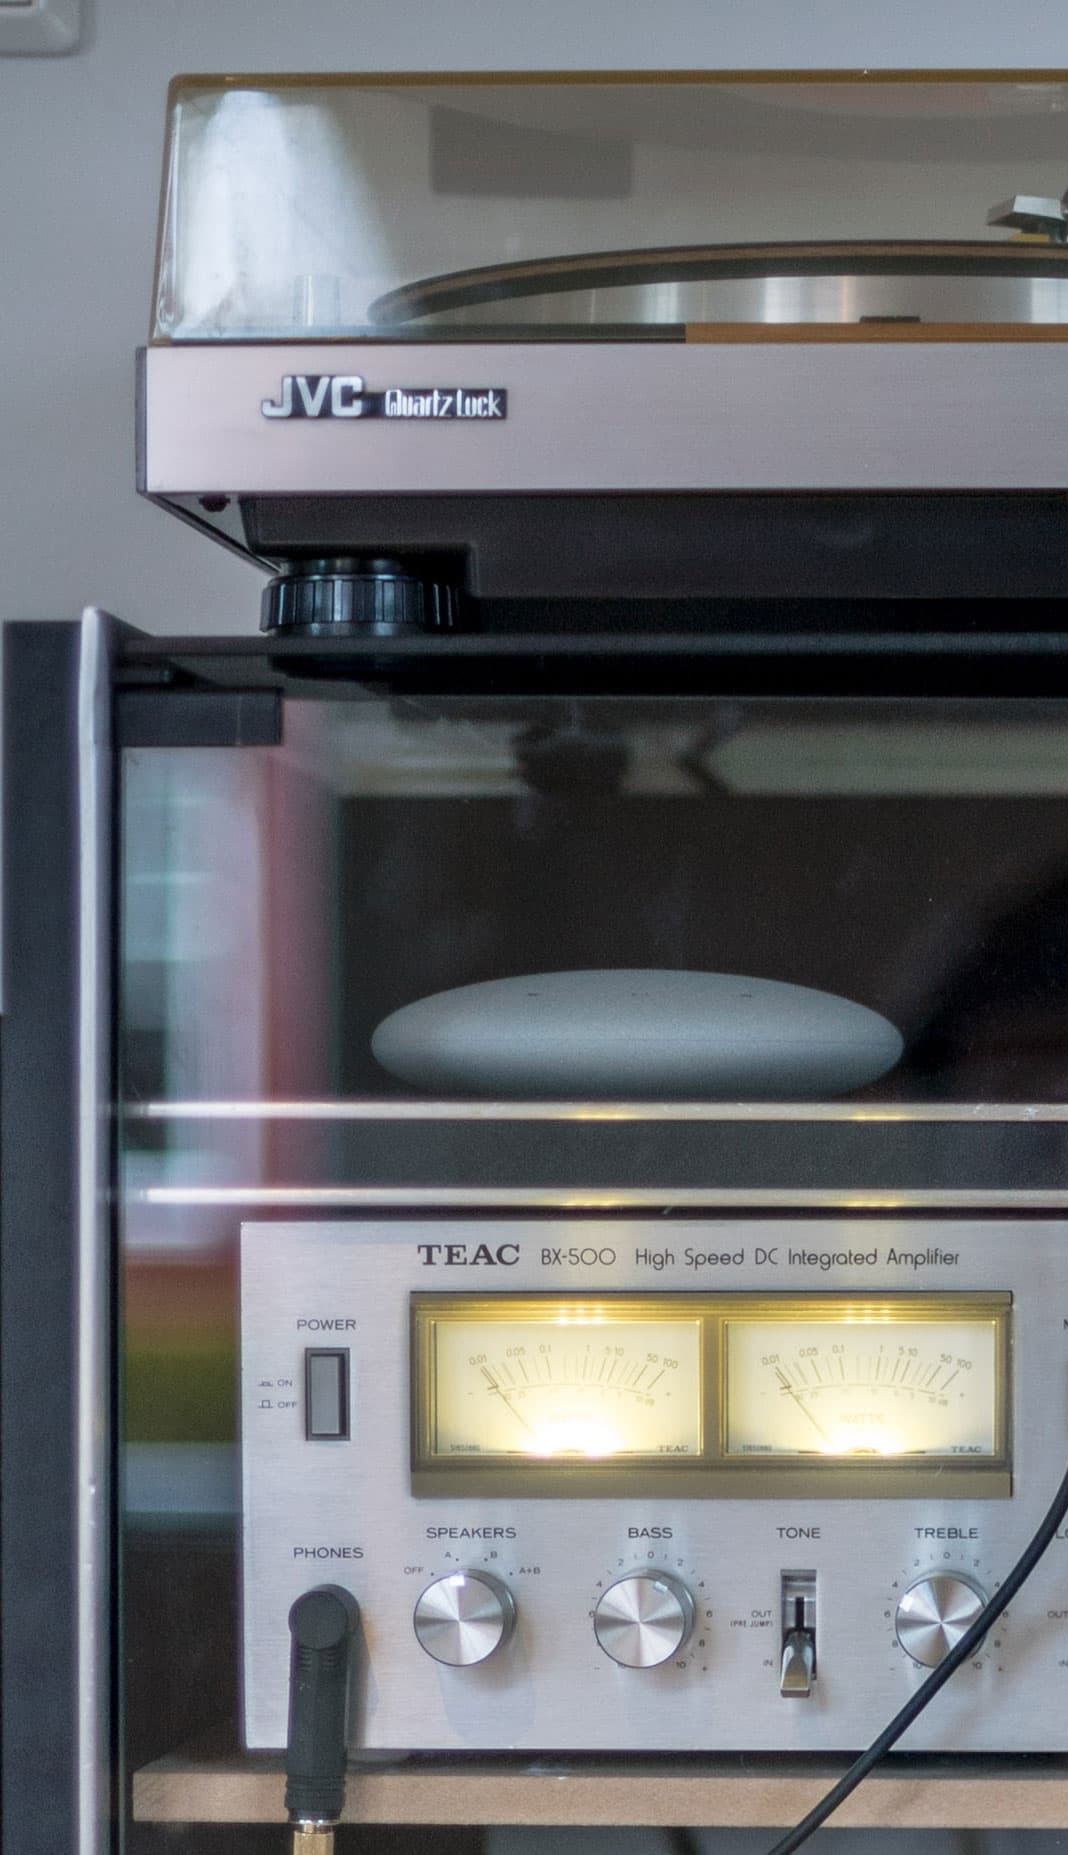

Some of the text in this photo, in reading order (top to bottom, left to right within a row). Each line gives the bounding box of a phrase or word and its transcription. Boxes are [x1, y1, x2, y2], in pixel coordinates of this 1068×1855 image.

[261, 375, 364, 418] JVC
[384, 388, 452, 417] Quartz
[417, 1244, 960, 1271] TEAC BX-500 High Speed DC Integrated Amplifier
[296, 1319, 357, 1331] POWER
[506, 1347, 527, 1358] 0.05
[539, 1344, 552, 1354] 0.1
[799, 1347, 819, 1358] 0.05
[832, 1344, 845, 1354] 0.1
[908, 1347, 918, 1357] 10
[469, 1354, 488, 1366] 0.01
[646, 1353, 659, 1364] 50
[662, 1358, 679, 1370] 100
[762, 1354, 780, 1366] 0.01
[940, 1353, 953, 1365] 50
[956, 1358, 973, 1370] 100
[277, 1379, 293, 1387] ON
[277, 1401, 297, 1409] OFF
[658, 1445, 689, 1453] TEAC
[951, 1445, 982, 1454] TEAC
[426, 1527, 517, 1539] SPEAKERS
[628, 1527, 673, 1539] BASS
[776, 1527, 821, 1539] TONE
[914, 1527, 979, 1539] TREBLE
[293, 1547, 365, 1559] PHONES
[943, 1552, 951, 1560] 0
[617, 1559, 625, 1567] 2
[677, 1559, 684, 1567] 2
[914, 1559, 920, 1567] 2
[404, 1567, 425, 1575] OFF
[519, 1567, 541, 1575] A+B
[751, 1610, 773, 1618] OUT
[1047, 1611, 1068, 1619] OUT
